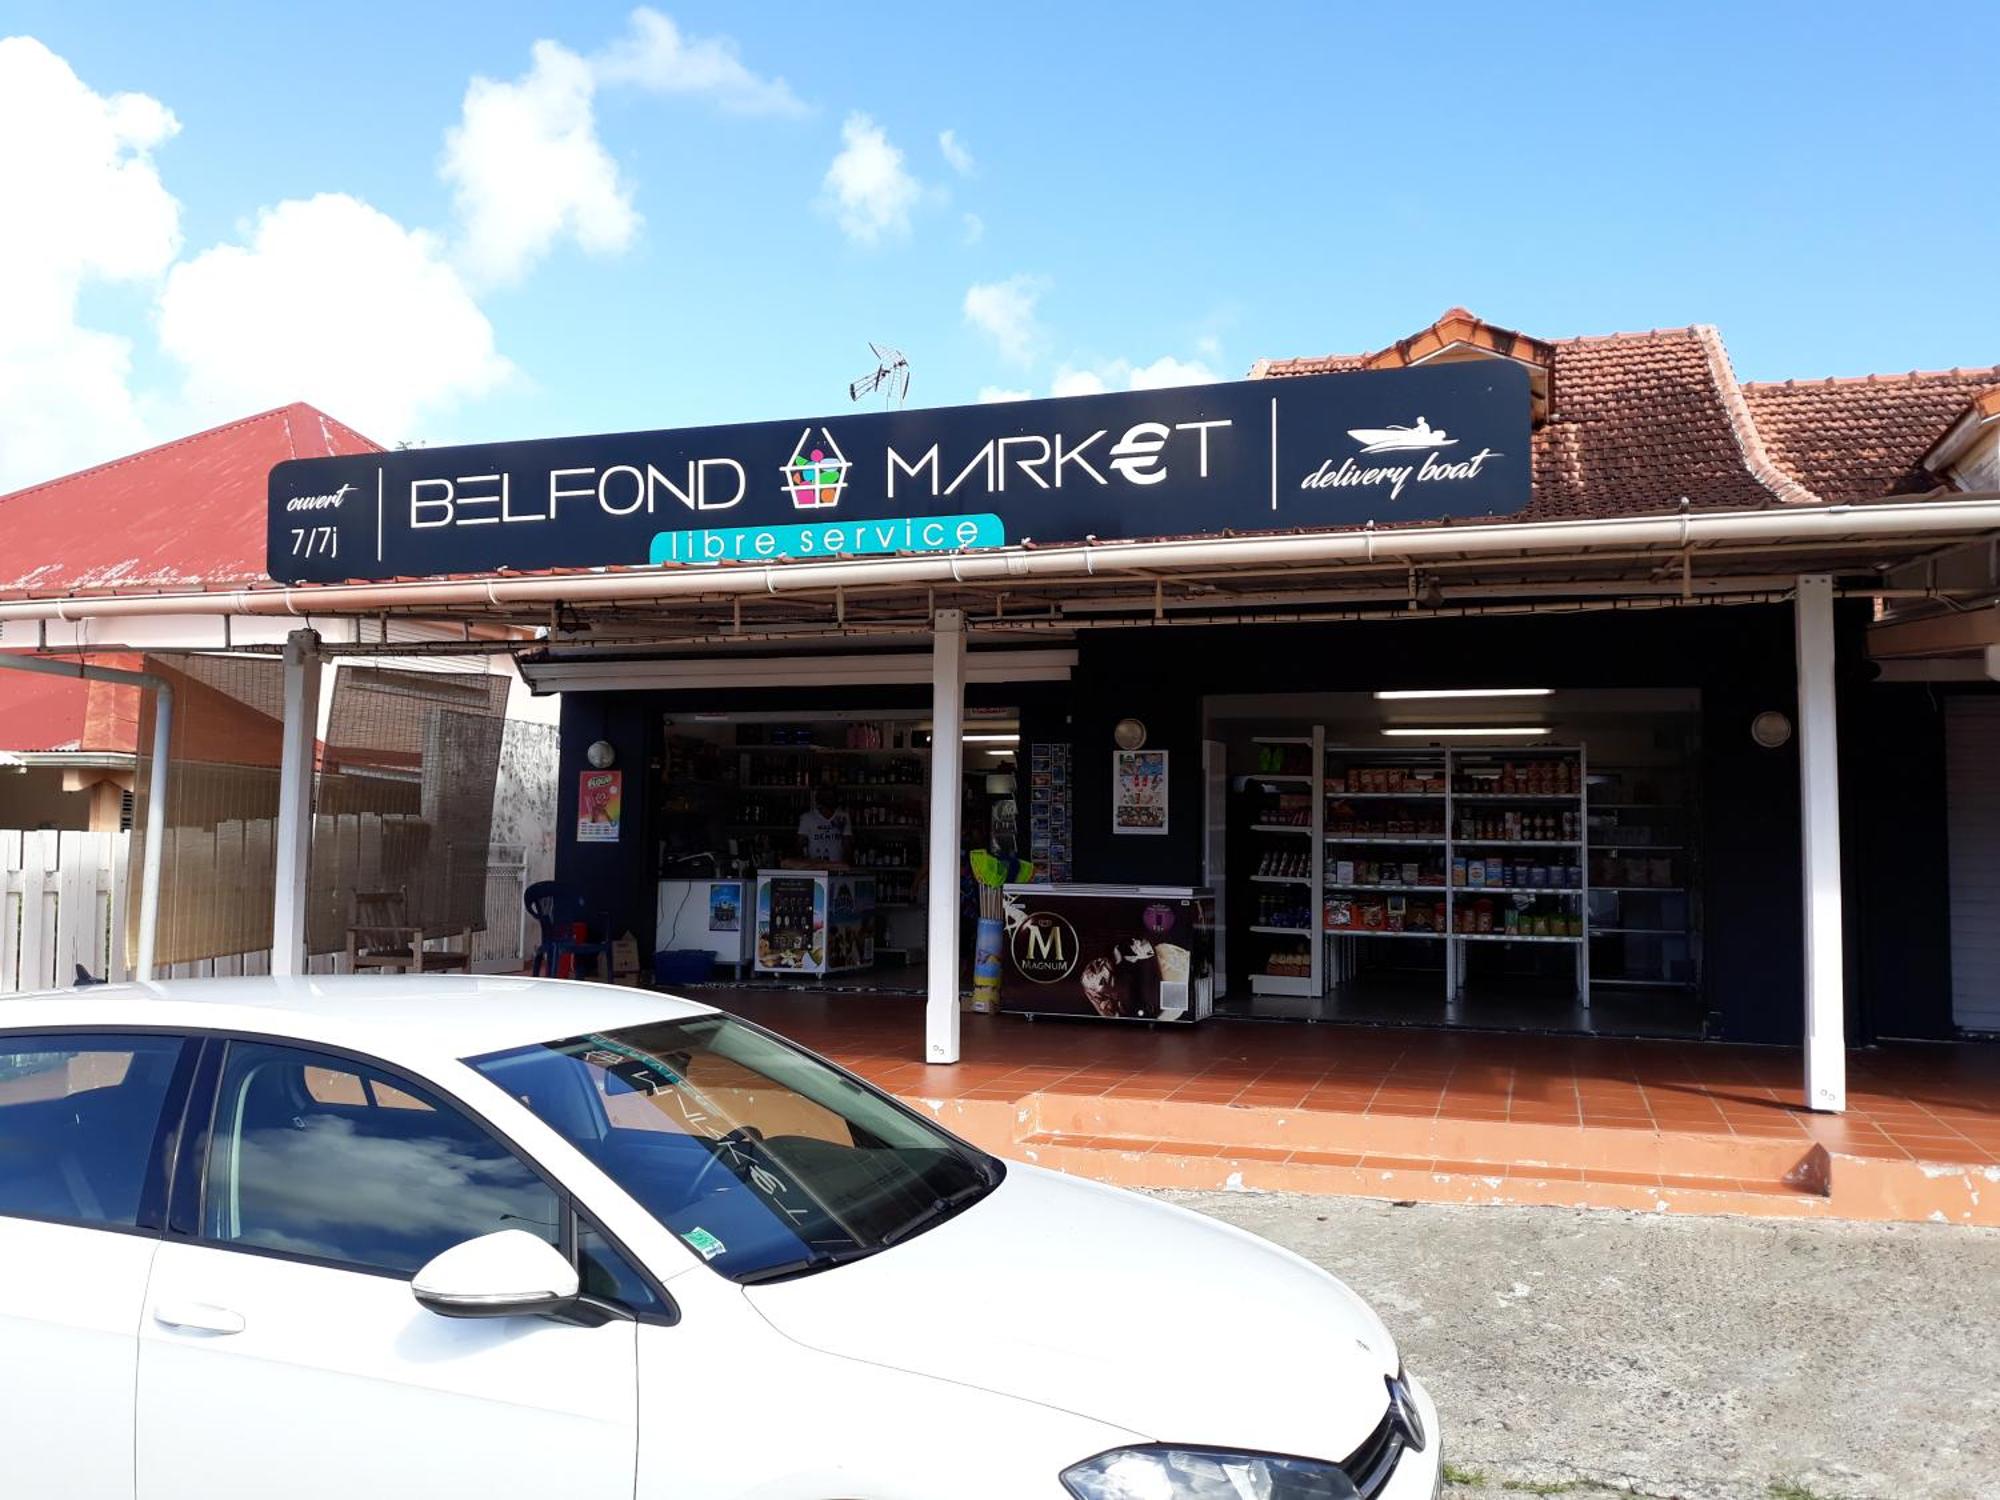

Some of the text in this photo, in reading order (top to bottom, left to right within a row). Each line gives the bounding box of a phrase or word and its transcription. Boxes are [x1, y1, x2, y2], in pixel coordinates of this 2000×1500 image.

[1301, 447, 1505, 501] delivery boat
[286, 482, 358, 512] ouvert
[409, 457, 747, 529] BELFOND
[291, 525, 337, 559] 7/7j
[671, 518, 979, 560] libre service
[1024, 924, 1065, 961] M
[1021, 958, 1068, 972] MAGNUM
